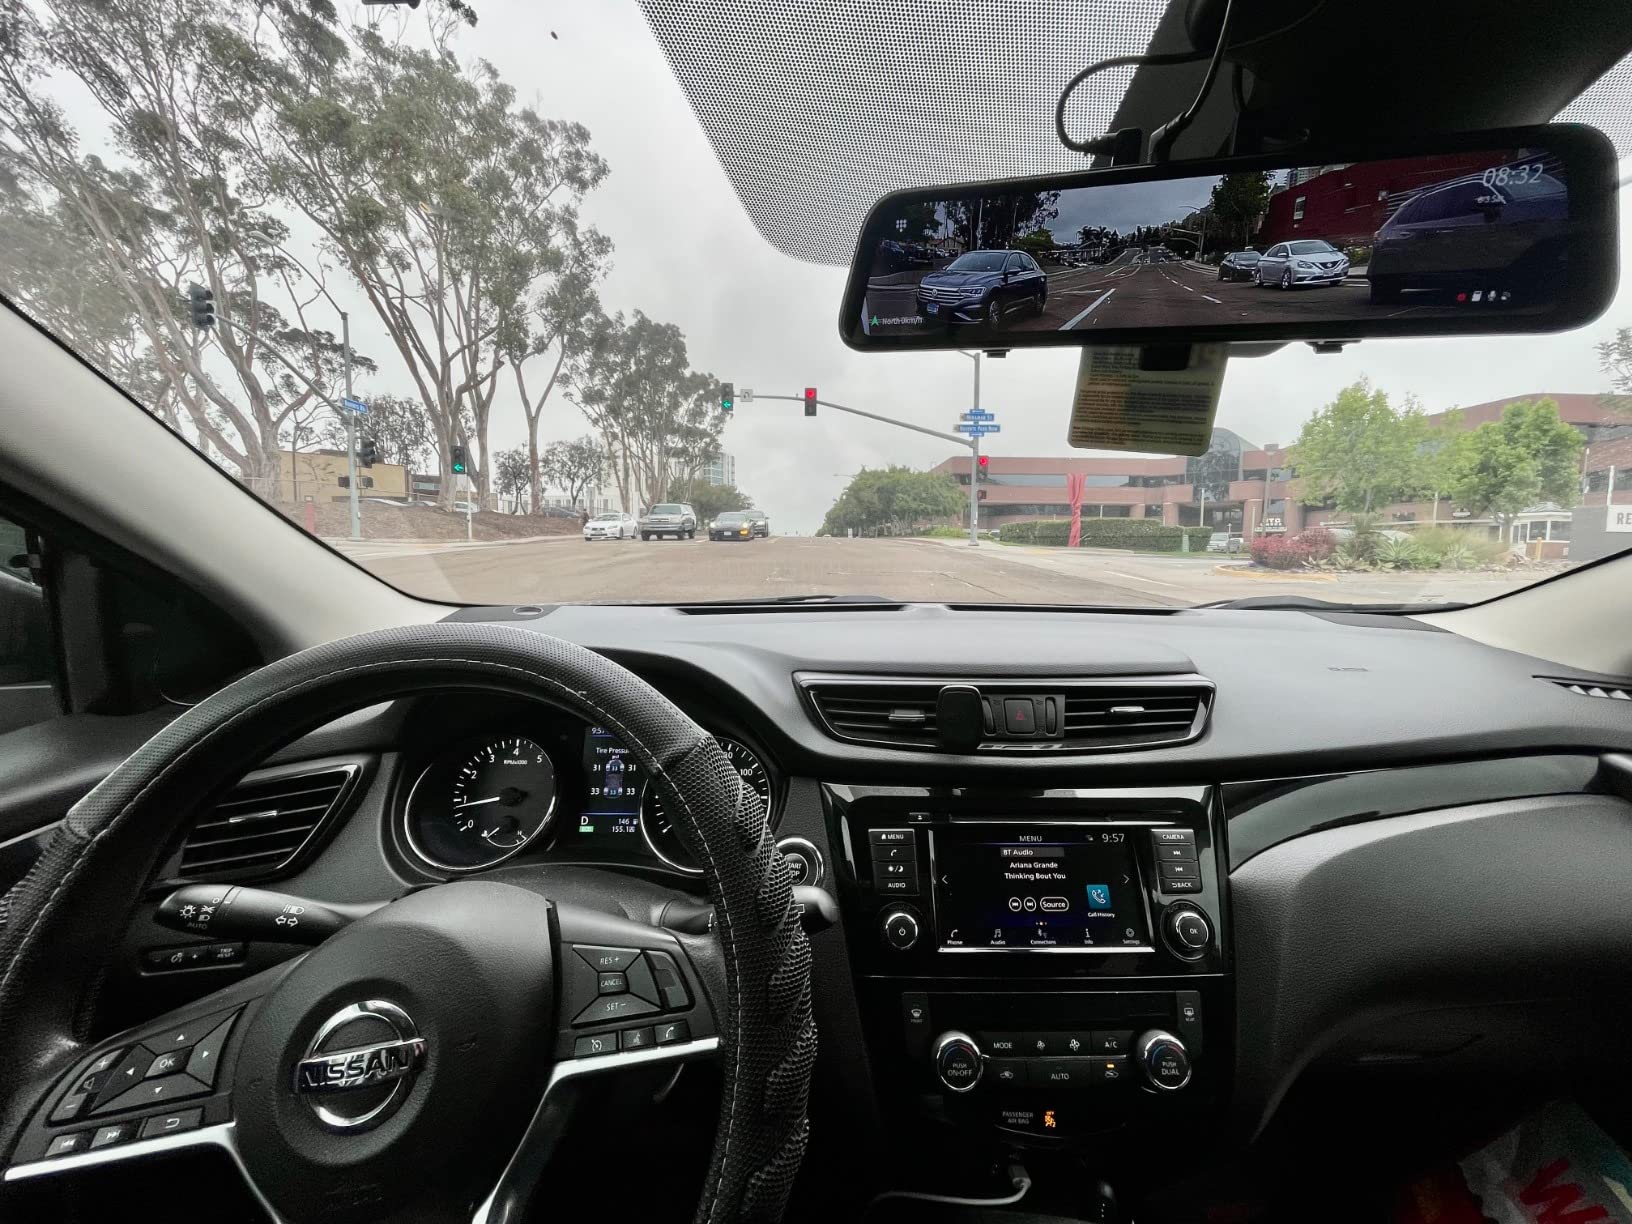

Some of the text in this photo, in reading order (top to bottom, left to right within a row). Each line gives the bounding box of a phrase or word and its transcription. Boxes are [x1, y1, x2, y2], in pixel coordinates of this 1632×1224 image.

[1482, 164, 1543, 186] 08:32
[882, 317, 902, 325] North
[513, 747, 519, 756] 4
[489, 754, 495, 763] 3
[536, 754, 543, 764] 5
[593, 764, 601, 772] 31
[628, 764, 637, 772] 31
[740, 768, 753, 776] 100
[470, 770, 477, 780] 2
[590, 787, 600, 796] 33
[626, 787, 636, 796] 33
[467, 819, 474, 829] 0
[580, 816, 589, 825] D
[1101, 833, 1125, 843] 9:57
[787, 862, 803, 870] TART
[1004, 872, 1035, 881] Thinking
[1035, 872, 1052, 880] Bout
[187, 922, 208, 930] AUTO
[600, 957, 613, 965] RES
[600, 978, 623, 987] CANCEL
[606, 1002, 619, 1011] SET
[1104, 1041, 1118, 1049] A/C
[159, 1057, 175, 1068] OK
[303, 1048, 410, 1087] NISSAN
[1161, 1068, 1180, 1076] DUAL
